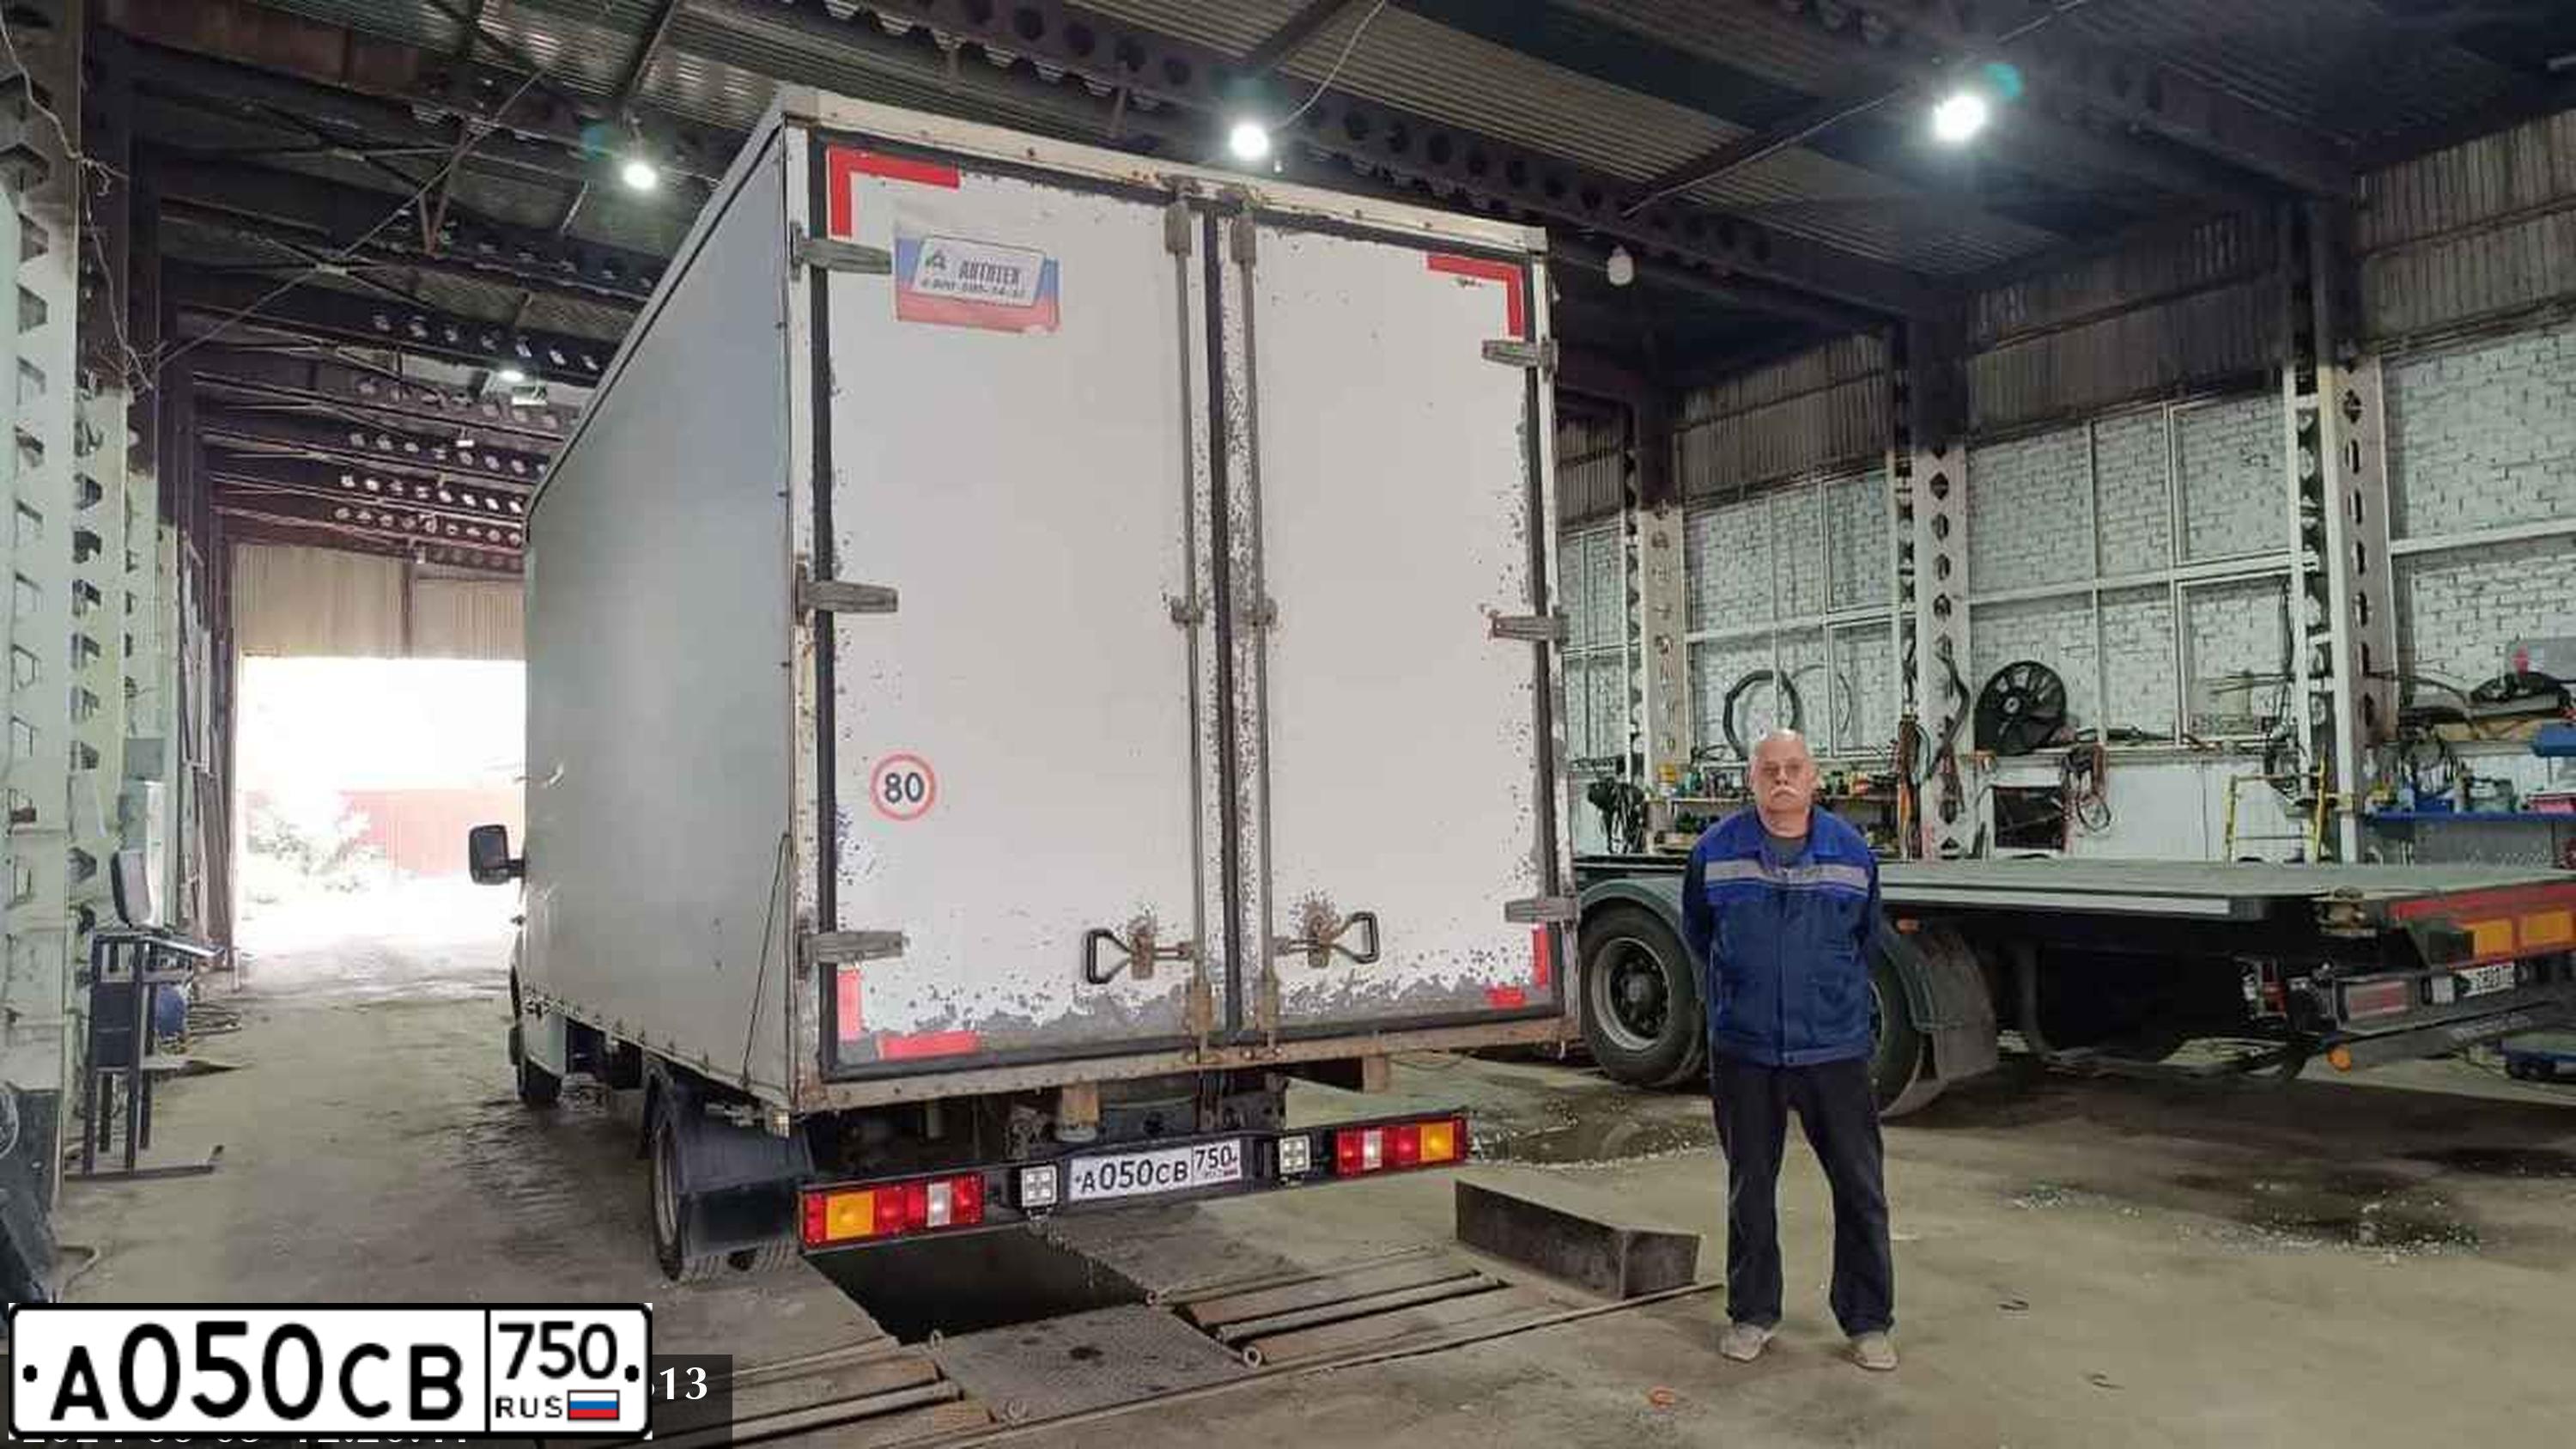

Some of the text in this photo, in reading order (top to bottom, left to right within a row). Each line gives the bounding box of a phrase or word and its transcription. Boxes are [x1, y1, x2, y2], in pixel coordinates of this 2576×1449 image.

[884, 772, 925, 805] 80
[1081, 1146, 1231, 1193] А050СВ 750
